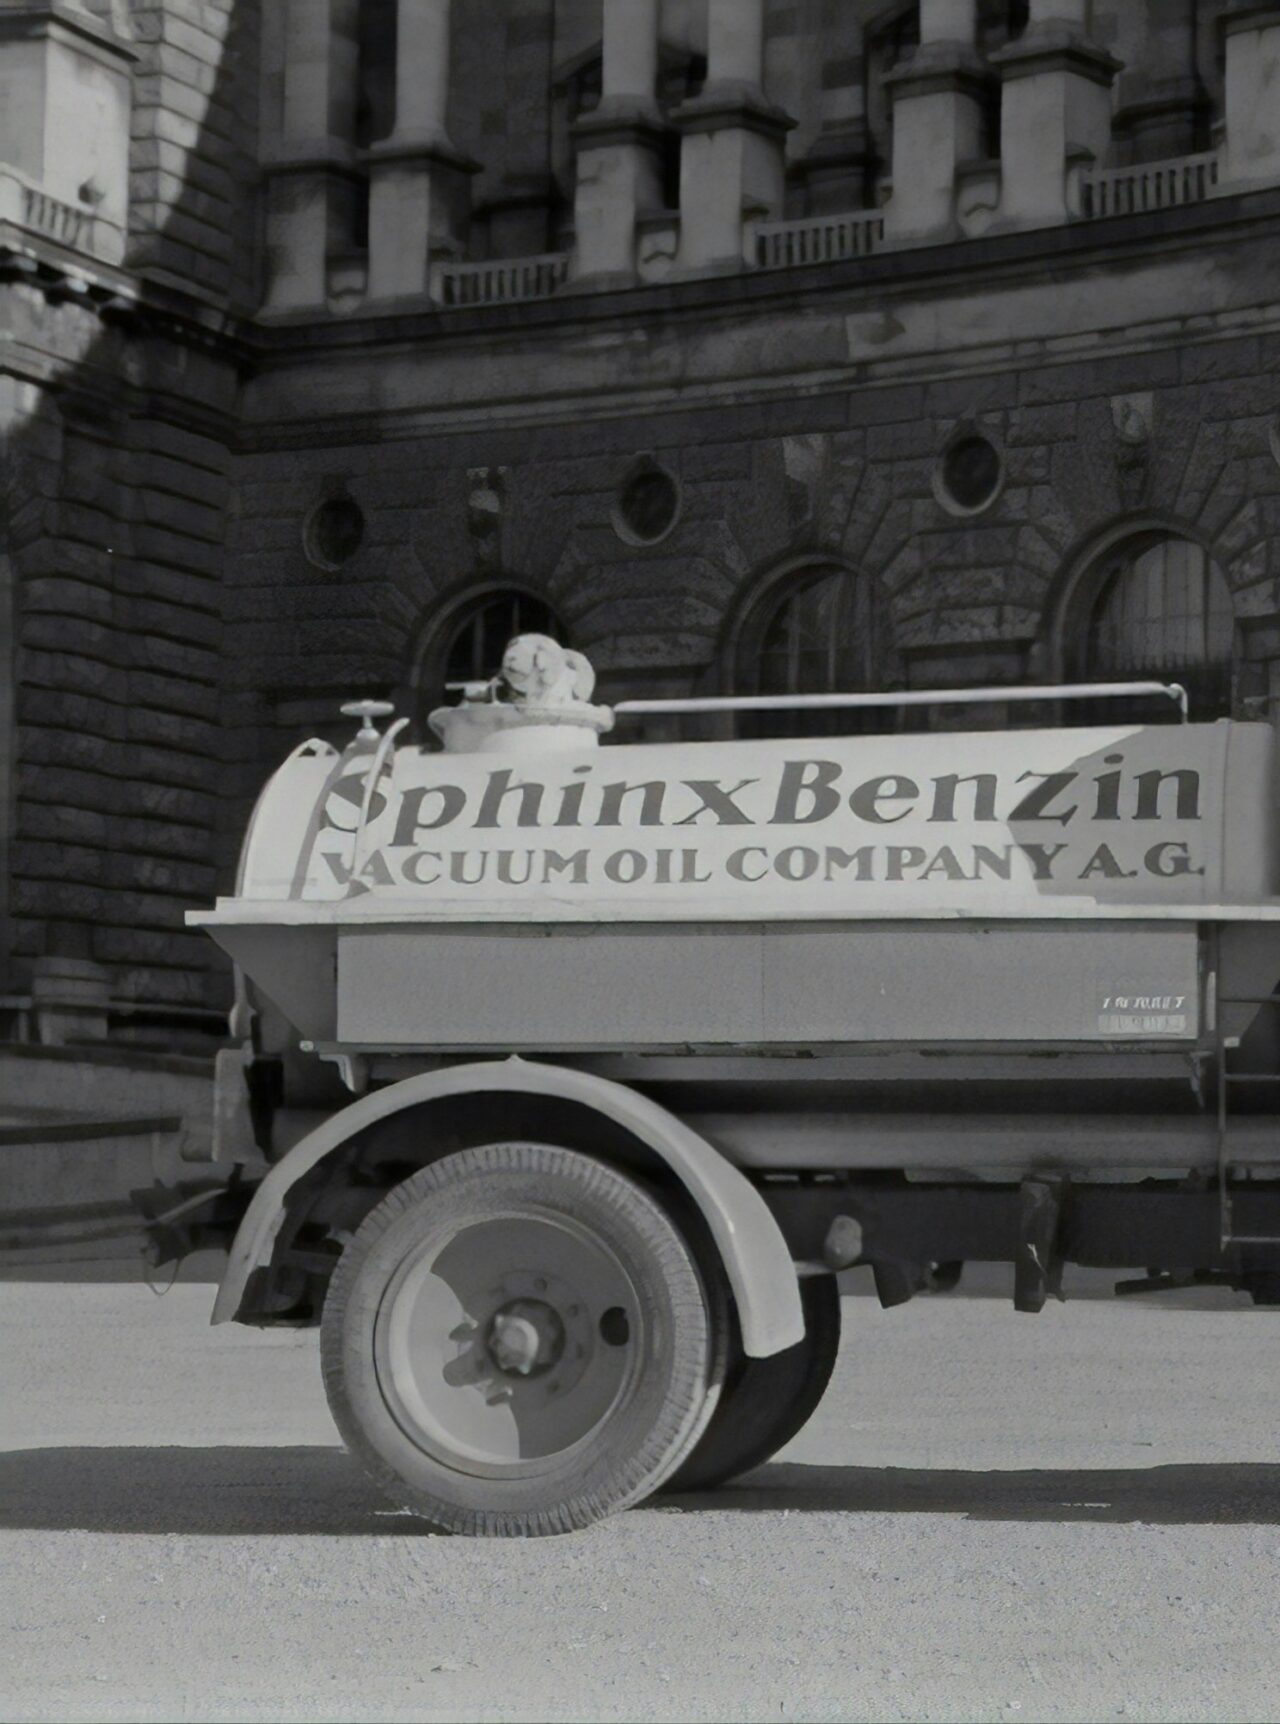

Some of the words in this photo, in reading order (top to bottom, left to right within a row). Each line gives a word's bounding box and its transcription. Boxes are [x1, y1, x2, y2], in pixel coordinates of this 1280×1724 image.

[321, 848, 590, 887] VACUUM
[604, 848, 712, 884] OIL
[726, 844, 1068, 882] COMPANY
